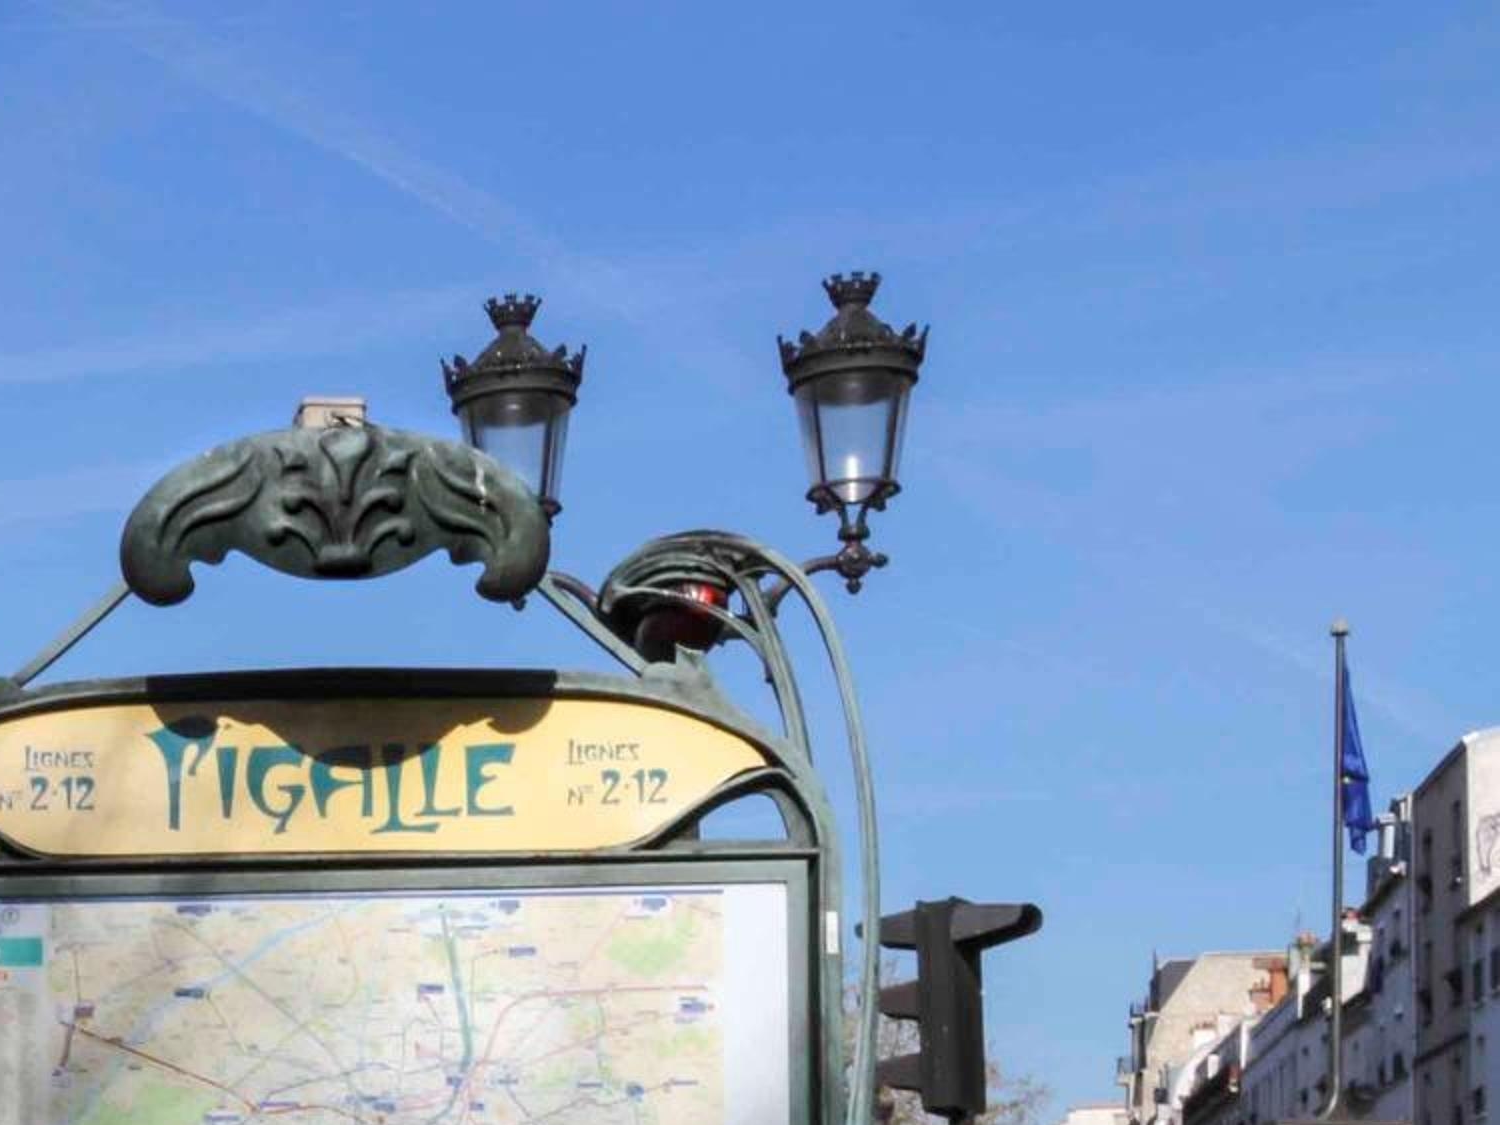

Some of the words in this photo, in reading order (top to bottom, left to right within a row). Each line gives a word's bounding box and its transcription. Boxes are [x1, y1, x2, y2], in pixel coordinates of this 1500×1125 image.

[25, 745, 95, 771] LIGNES
[565, 739, 640, 765] LIGNES
[146, 715, 515, 834] PIGALLE
